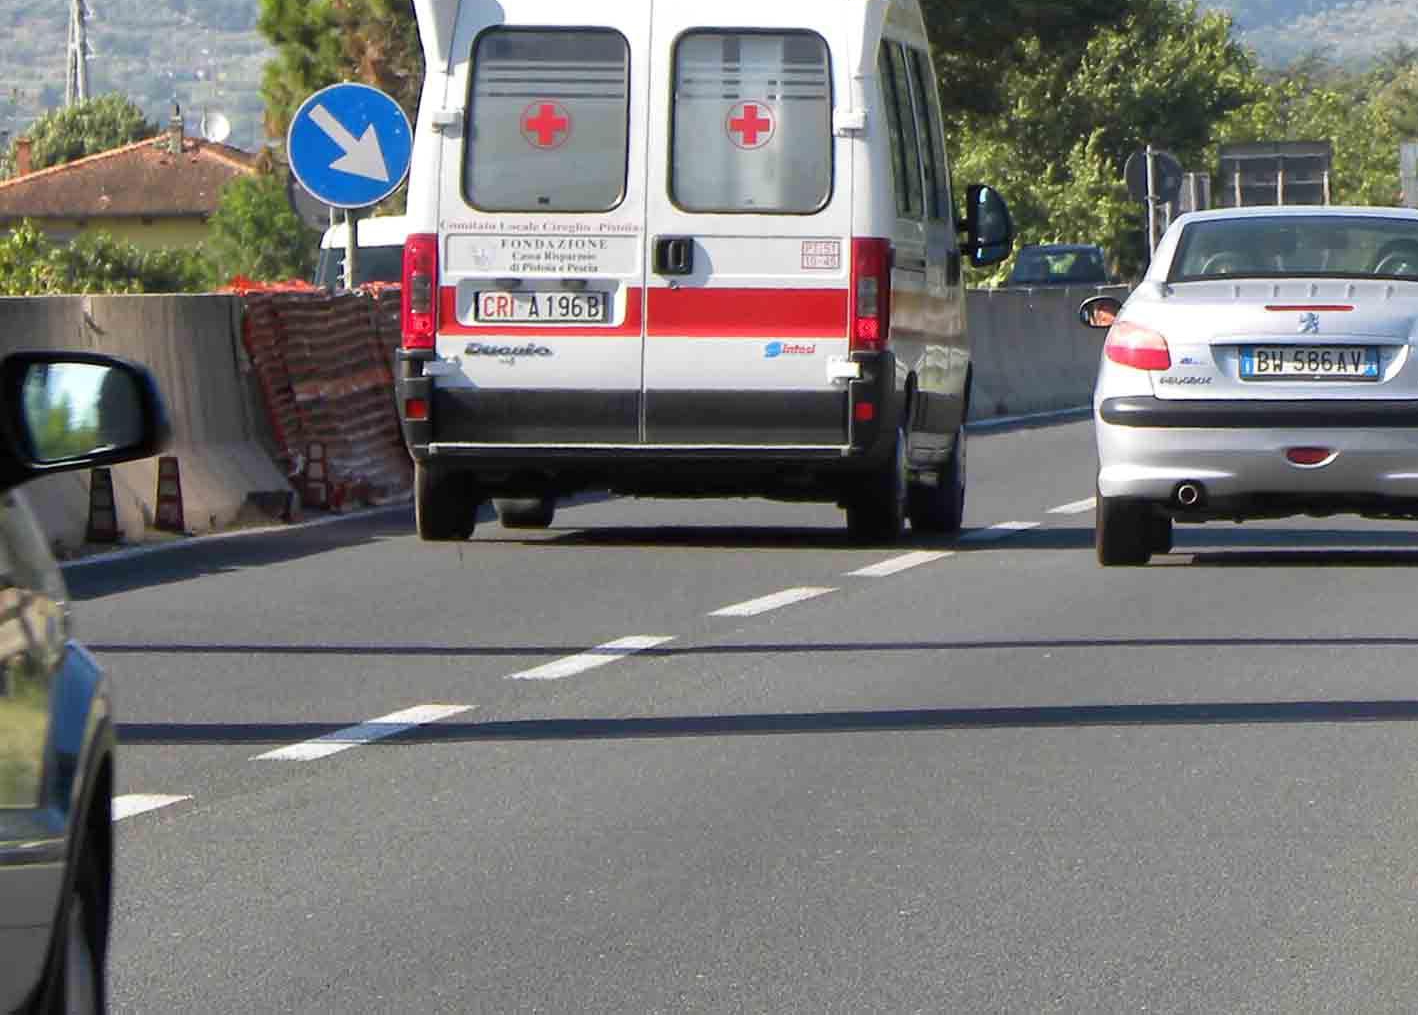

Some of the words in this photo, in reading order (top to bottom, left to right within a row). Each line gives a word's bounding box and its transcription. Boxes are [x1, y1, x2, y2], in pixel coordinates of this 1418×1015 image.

[440, 219, 497, 230] Comitato
[500, 220, 540, 231] Locale
[500, 238, 609, 250] FONDAZIONE
[512, 251, 541, 261] Cassa
[544, 251, 597, 263] Risparmio
[509, 262, 520, 272] di
[522, 263, 557, 273] Pistoia
[567, 263, 599, 273] Pescia
[483, 296, 515, 318] CRI
[464, 342, 552, 357] Ducato
